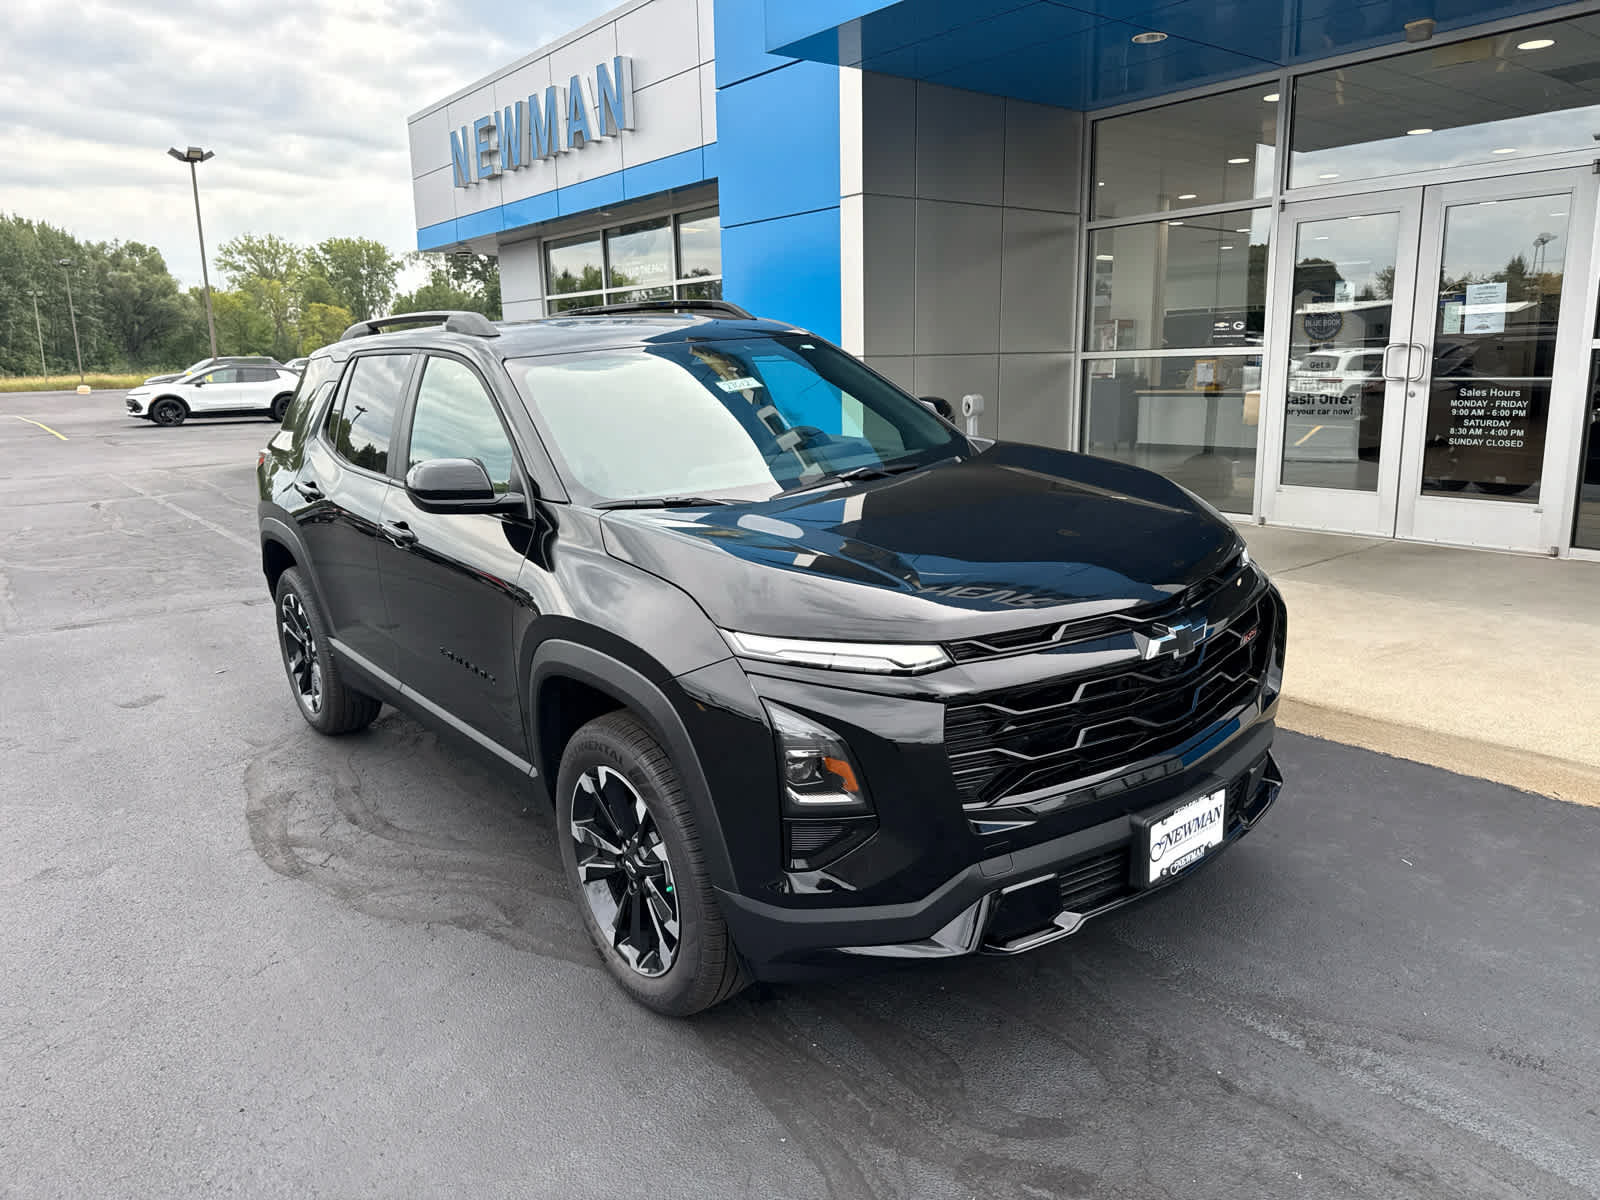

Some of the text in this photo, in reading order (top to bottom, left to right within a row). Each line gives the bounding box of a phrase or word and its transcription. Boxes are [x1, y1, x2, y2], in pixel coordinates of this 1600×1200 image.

[450, 56, 634, 188] NEWMAN
[1310, 361, 1324, 369] Get
[1460, 388, 1521, 397] Sales Hours
[1492, 409, 1510, 417] 6:00
[1463, 419, 1511, 427] SATURDAY
[1449, 427, 1467, 435] 8:30
[1469, 428, 1483, 436] AM
[1448, 438, 1524, 447] SUNDAY CLOSED
[1150, 805, 1223, 862] NEWMAN
